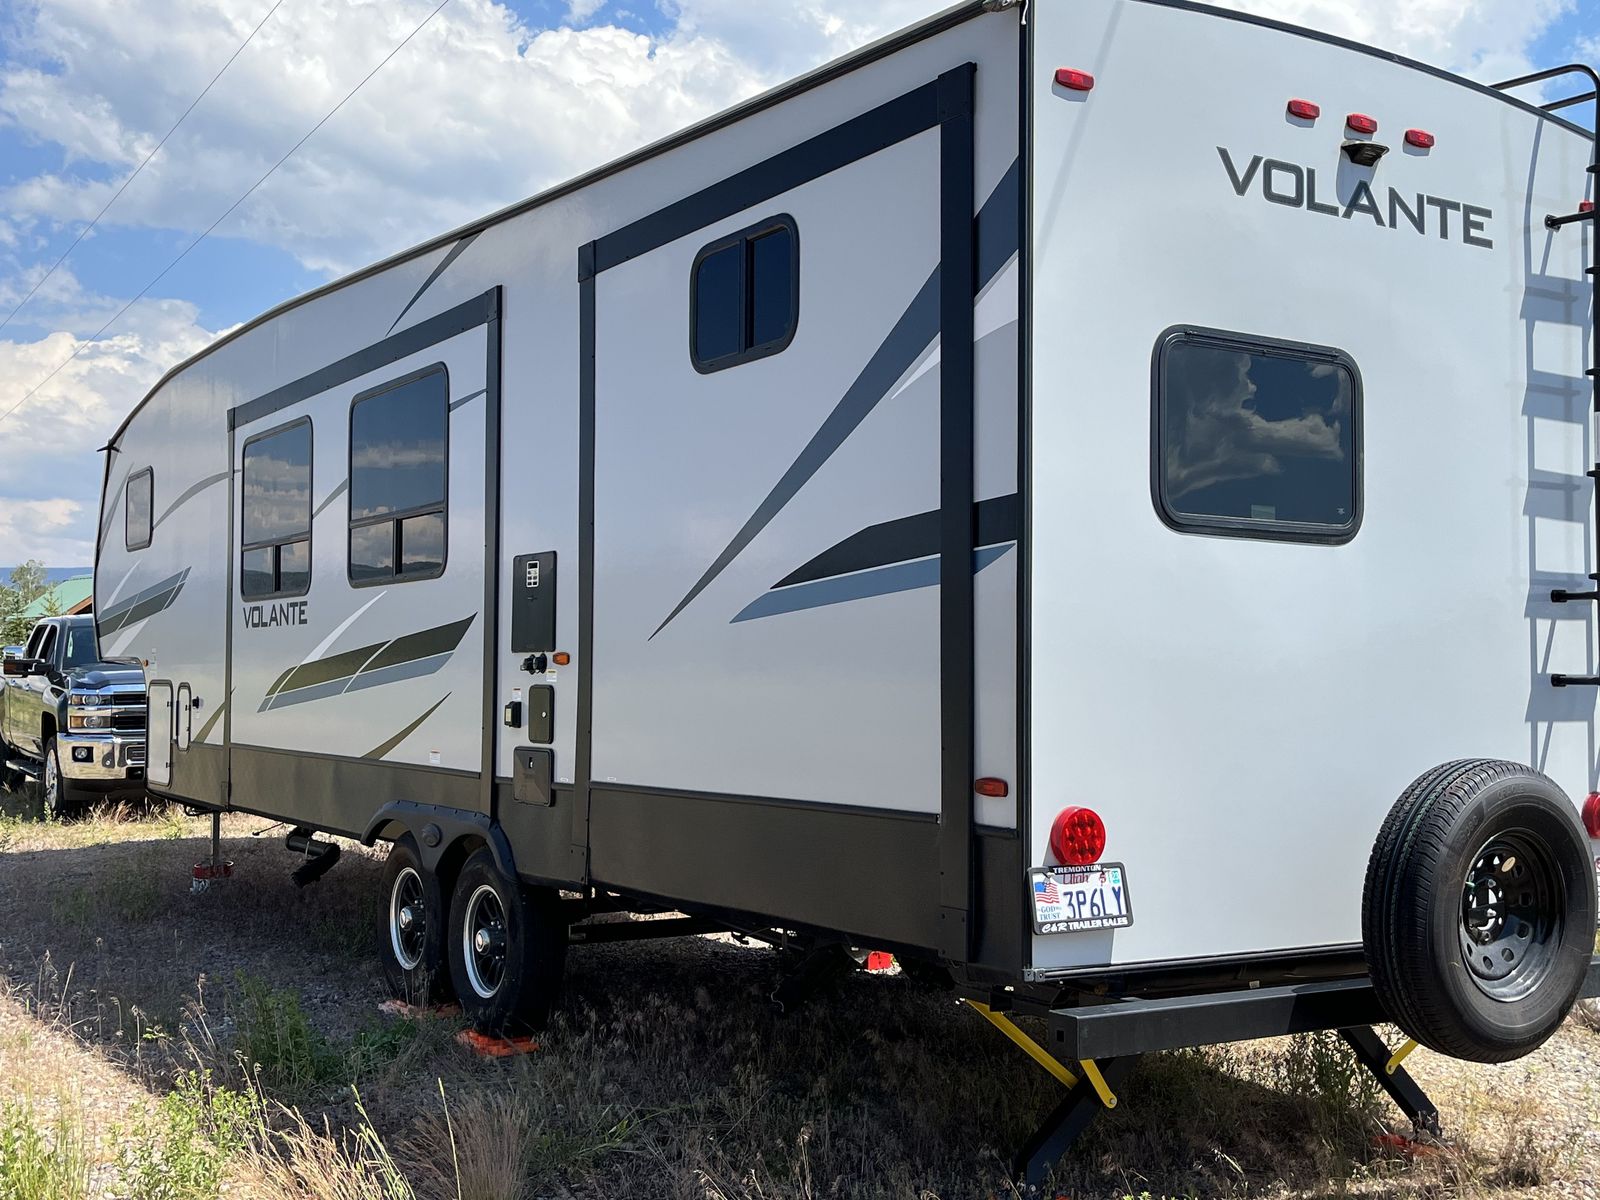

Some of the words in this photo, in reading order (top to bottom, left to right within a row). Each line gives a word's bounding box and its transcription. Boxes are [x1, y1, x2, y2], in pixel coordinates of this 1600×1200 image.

[1215, 145, 1494, 250] VOLANTE
[242, 600, 308, 629] VOLANTE
[1053, 864, 1102, 874] TREMONTON
[1062, 886, 1122, 920] 3P6LY
[1040, 912, 1061, 921] TRUST
[1068, 919, 1103, 931] TRAILER
[1102, 917, 1128, 927] SALES
